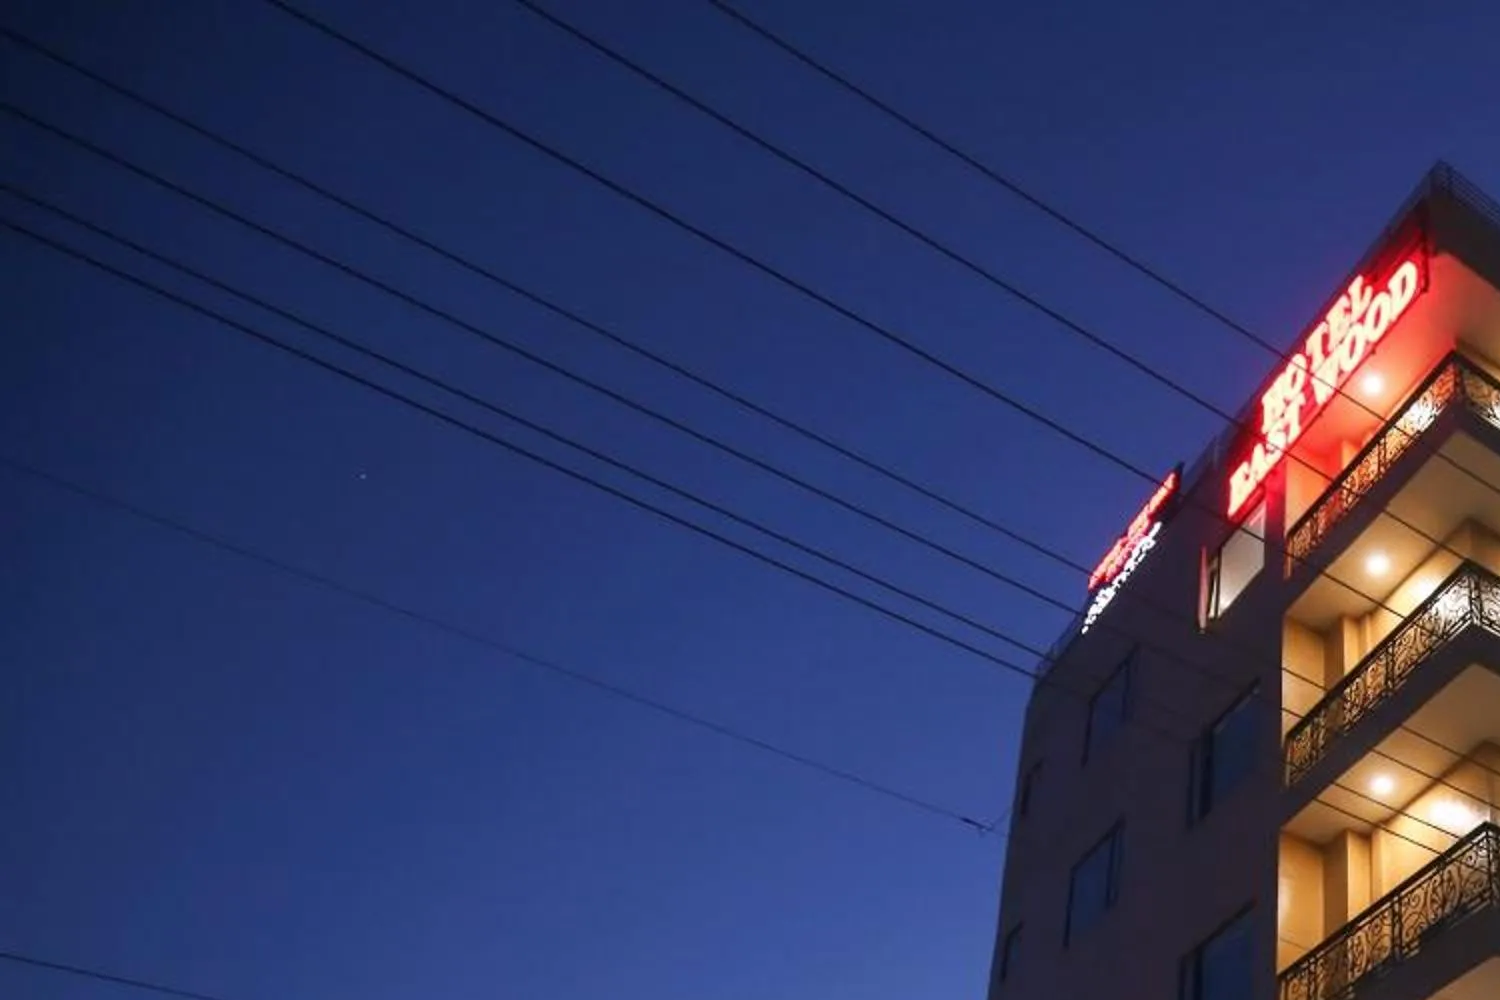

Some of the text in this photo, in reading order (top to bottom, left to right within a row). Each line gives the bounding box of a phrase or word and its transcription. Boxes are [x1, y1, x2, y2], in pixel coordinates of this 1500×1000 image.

[1228, 260, 1417, 516] EAST WOOD
[1262, 275, 1373, 434] HOTEL
